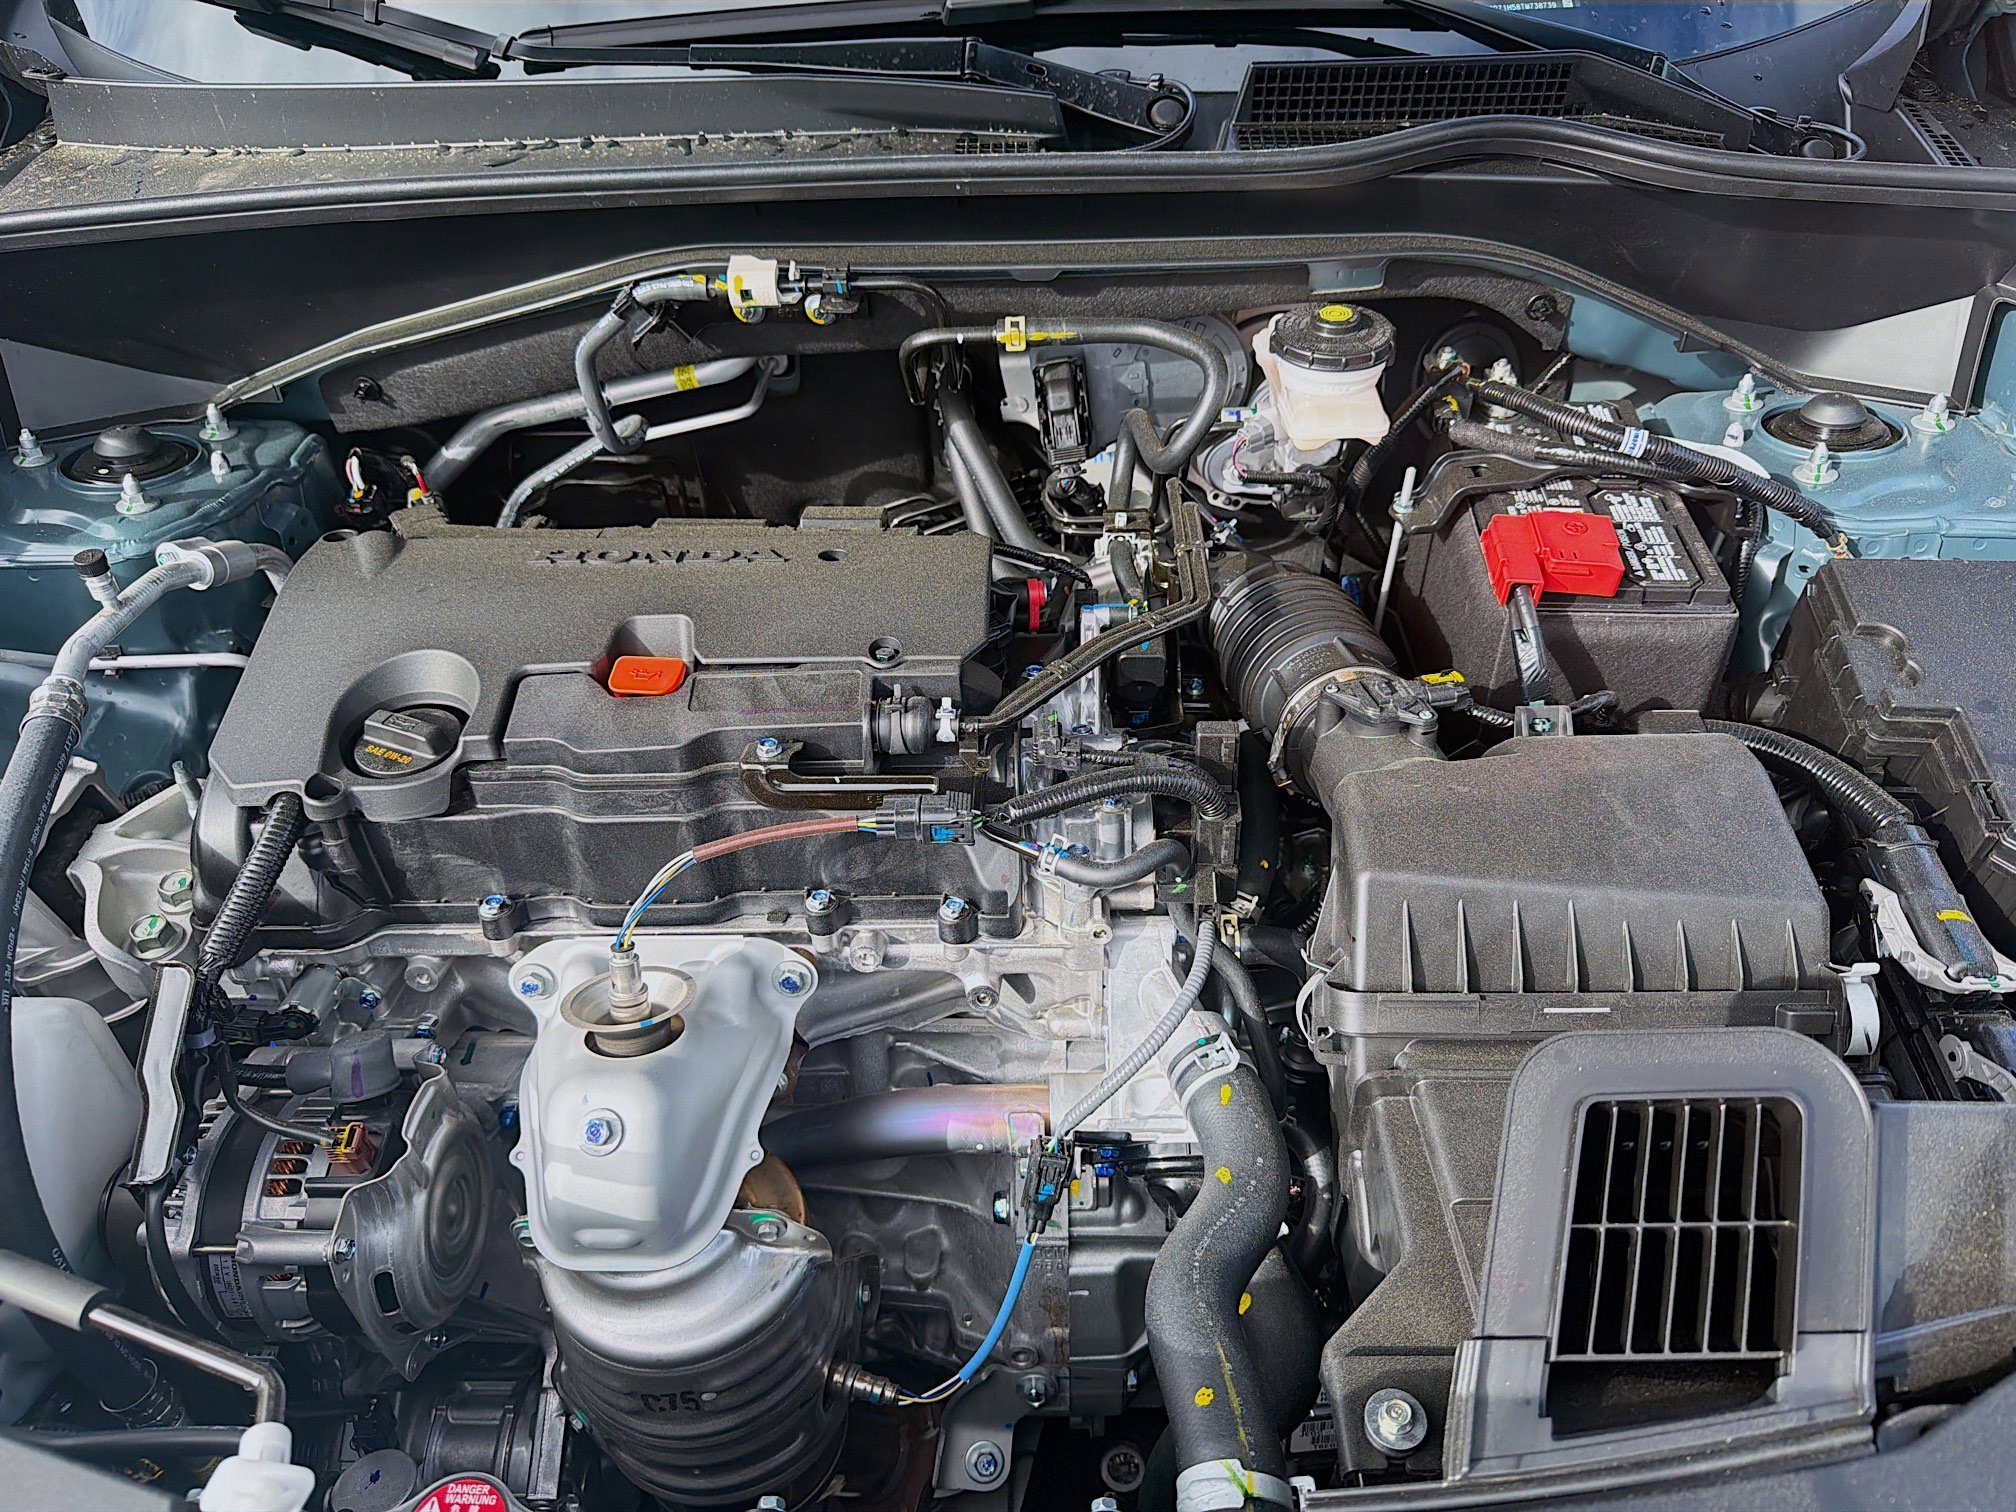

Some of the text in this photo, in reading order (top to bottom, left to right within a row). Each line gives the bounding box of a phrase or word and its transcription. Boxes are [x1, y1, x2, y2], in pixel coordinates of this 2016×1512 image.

[364, 744, 413, 764] SAE 0W-20
[30, 822, 41, 845] HOSE
[447, 1483, 490, 1494] DANGER
[445, 1493, 497, 1505] WARNUNG
